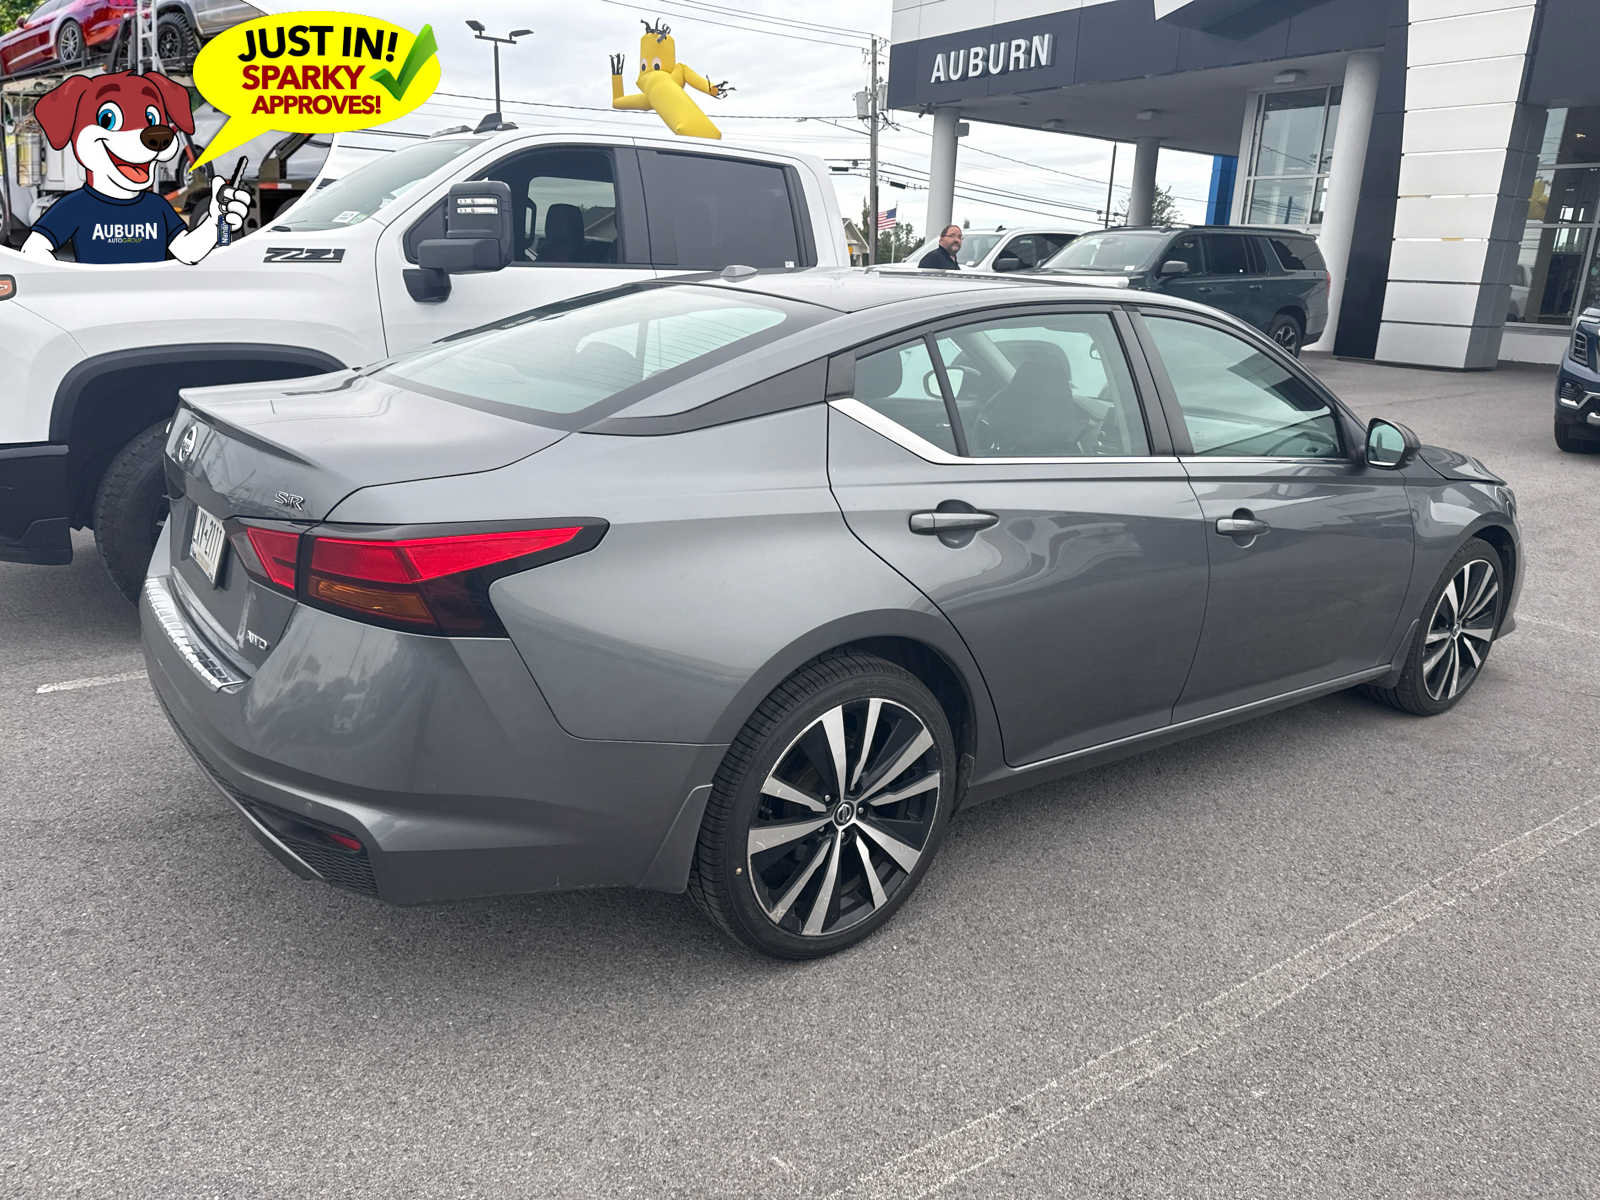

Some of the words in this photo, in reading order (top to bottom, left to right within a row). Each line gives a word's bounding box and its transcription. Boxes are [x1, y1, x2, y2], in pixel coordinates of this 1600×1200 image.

[930, 33, 1053, 83] AUBURN
[263, 247, 346, 263] Z71
[274, 491, 304, 511] SR
